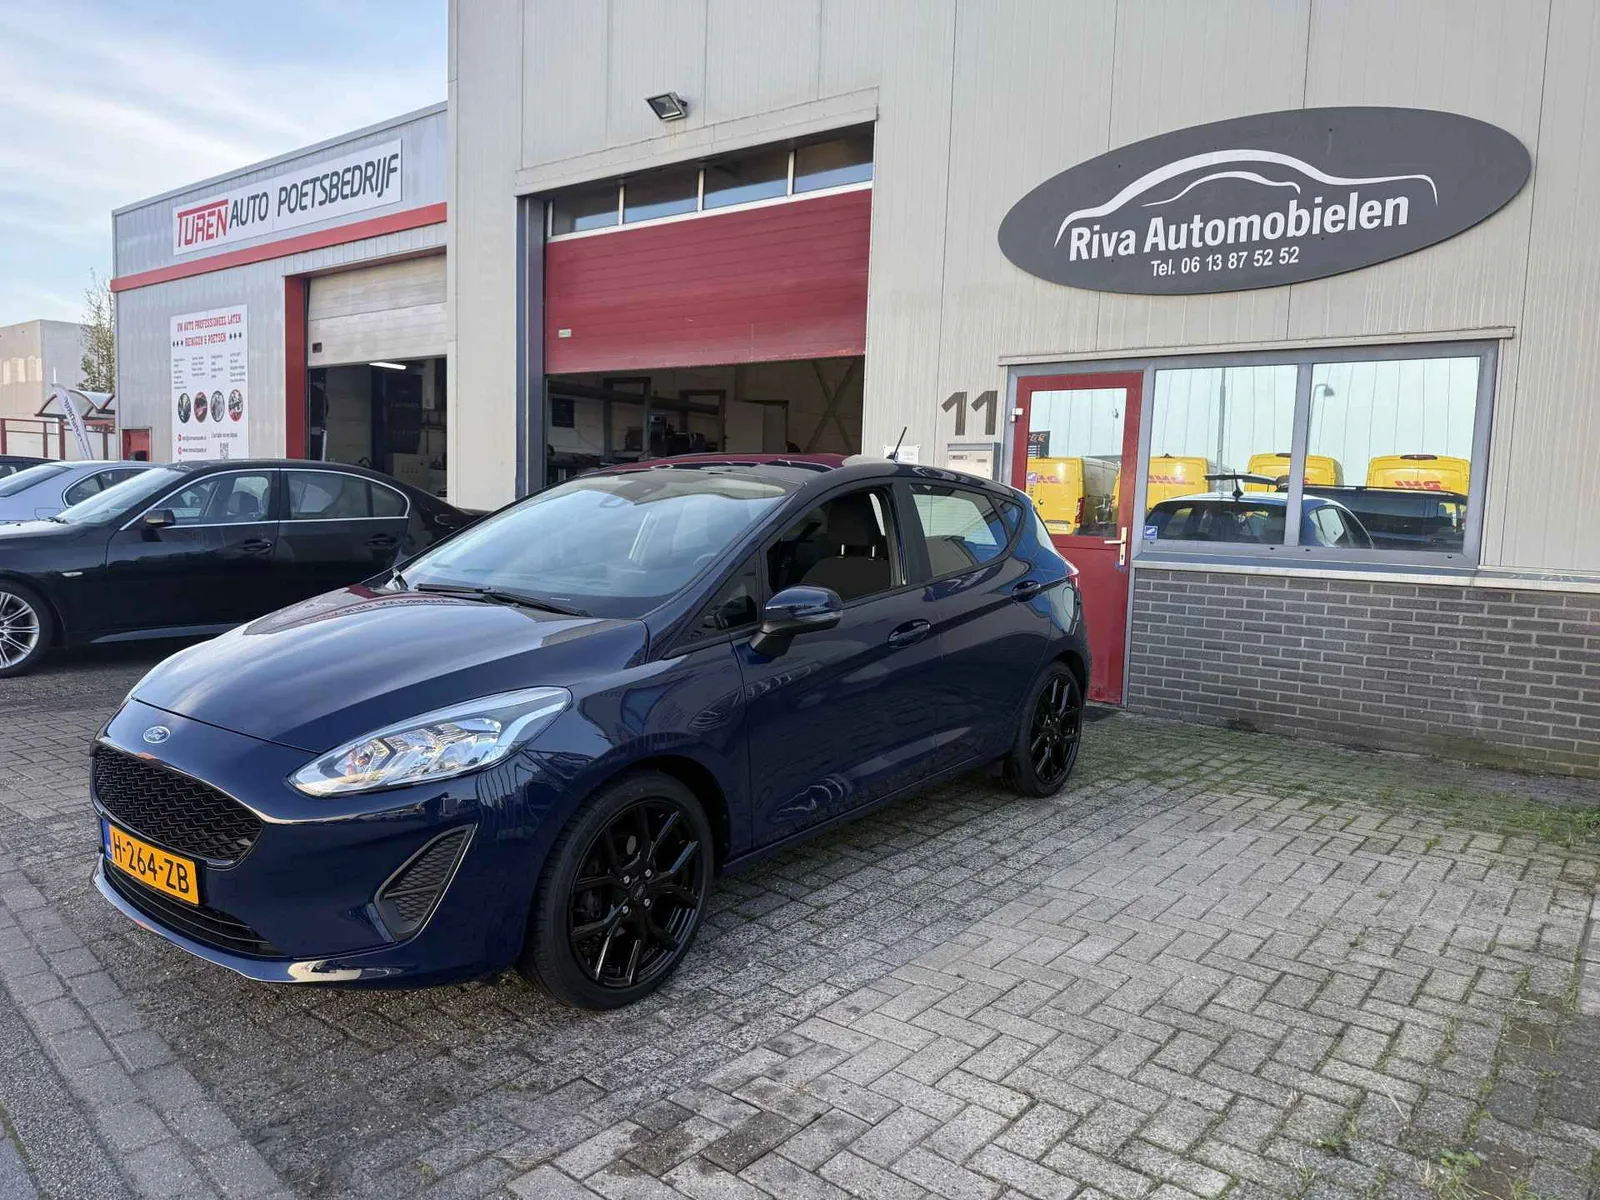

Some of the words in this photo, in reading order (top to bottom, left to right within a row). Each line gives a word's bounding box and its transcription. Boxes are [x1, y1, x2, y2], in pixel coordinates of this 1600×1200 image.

[177, 198, 229, 247] TUREN
[229, 191, 268, 229] AUTO
[277, 153, 399, 217] POETSBEDRIJF
[1069, 224, 1136, 261] Riva
[1143, 191, 1409, 253] Automobielen
[1150, 259, 1176, 277] Tel.
[1181, 256, 1200, 274] 06
[1206, 253, 1222, 271] 13
[1228, 251, 1248, 270] 87
[1253, 248, 1272, 267] 52
[1279, 245, 1299, 265] 52
[941, 390, 998, 436] 11
[113, 831, 190, 894] H-264-ZB
